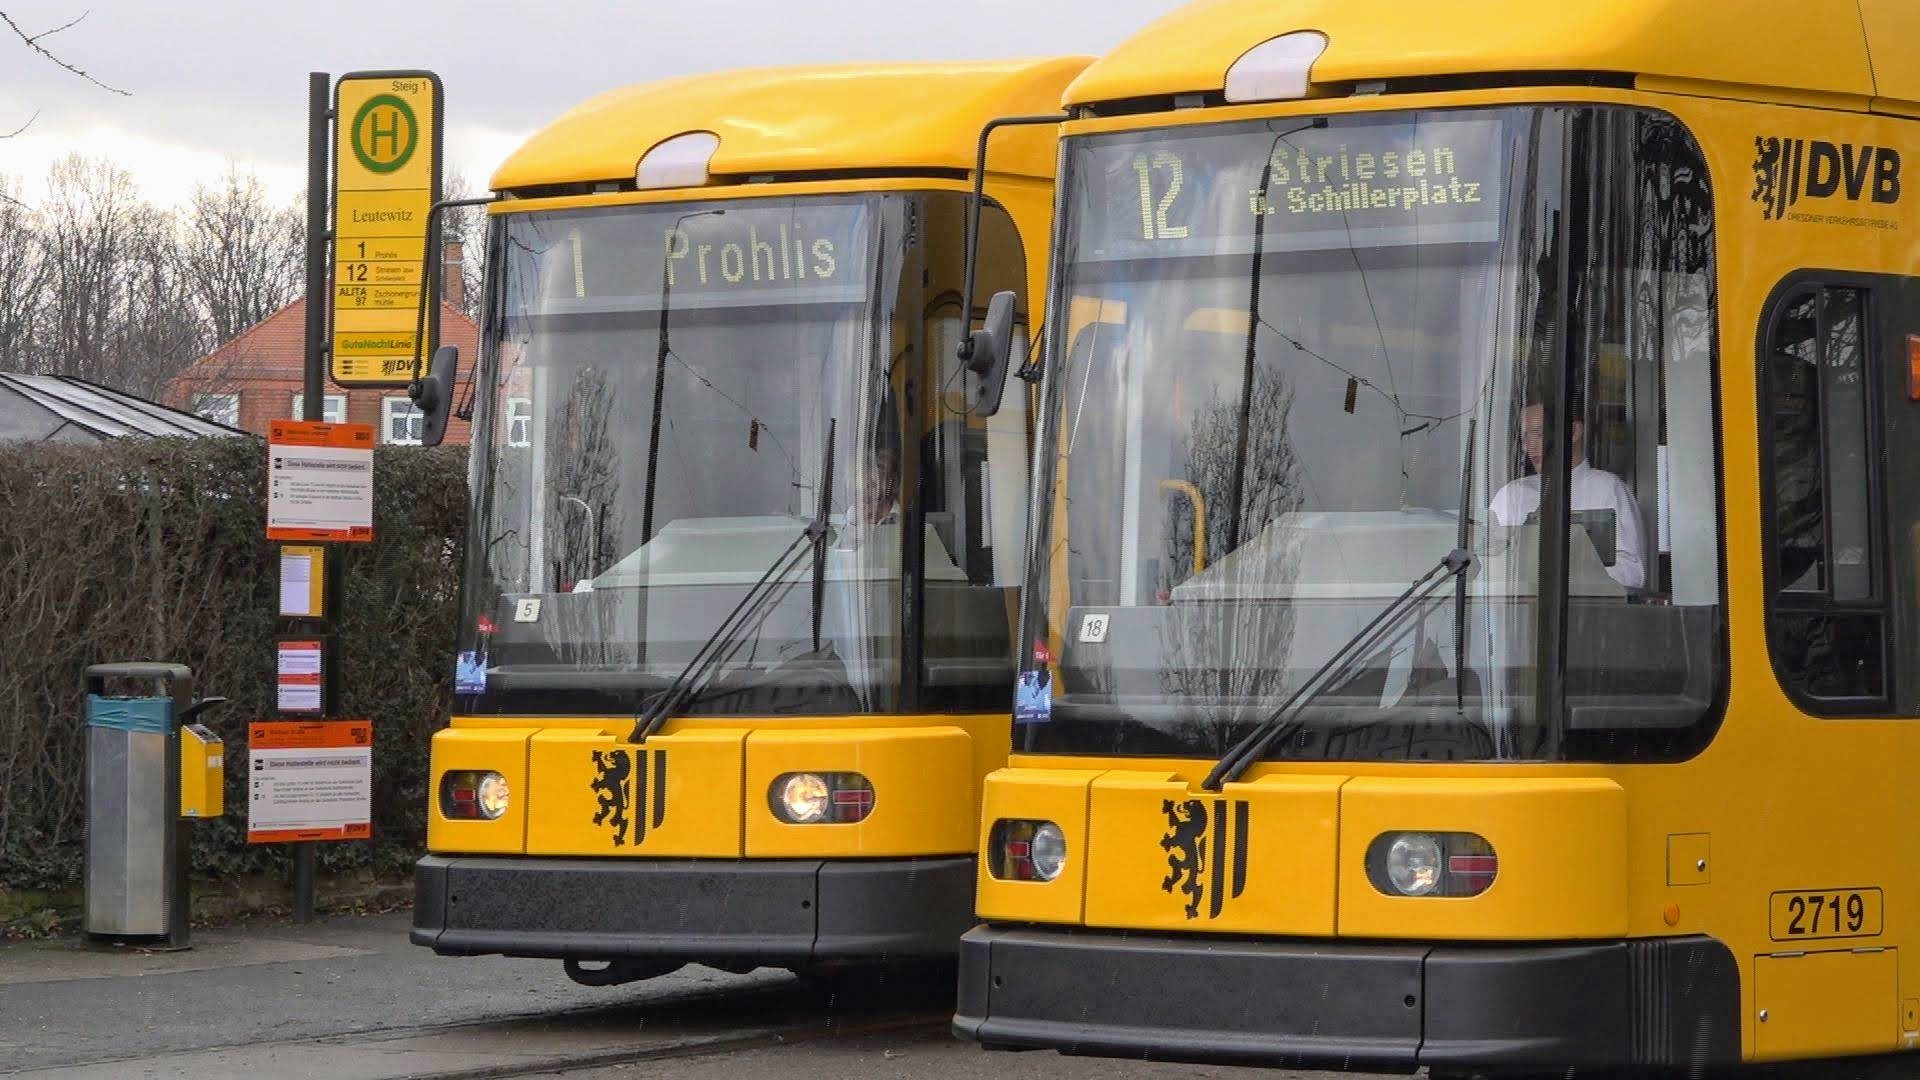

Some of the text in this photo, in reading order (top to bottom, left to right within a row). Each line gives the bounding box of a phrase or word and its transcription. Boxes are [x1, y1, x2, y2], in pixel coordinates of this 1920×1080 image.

[391, 80, 427, 94] Steig 1
[371, 111, 399, 157] H
[1270, 144, 1456, 185] Striesen
[1805, 140, 1901, 204] DVB
[1133, 149, 1189, 240] 12
[1288, 175, 1481, 213] Schillerplatz
[352, 208, 414, 223] Leutewitz
[358, 241, 398, 259] 1 Prohlis
[568, 227, 585, 297] 1
[664, 223, 836, 286] Prohlis
[346, 263, 368, 281] 12
[339, 287, 367, 297] ALITA
[355, 297, 368, 306] 97
[524, 603, 533, 617] 5
[1087, 619, 1103, 637] 18
[1788, 893, 1864, 935] 2719
